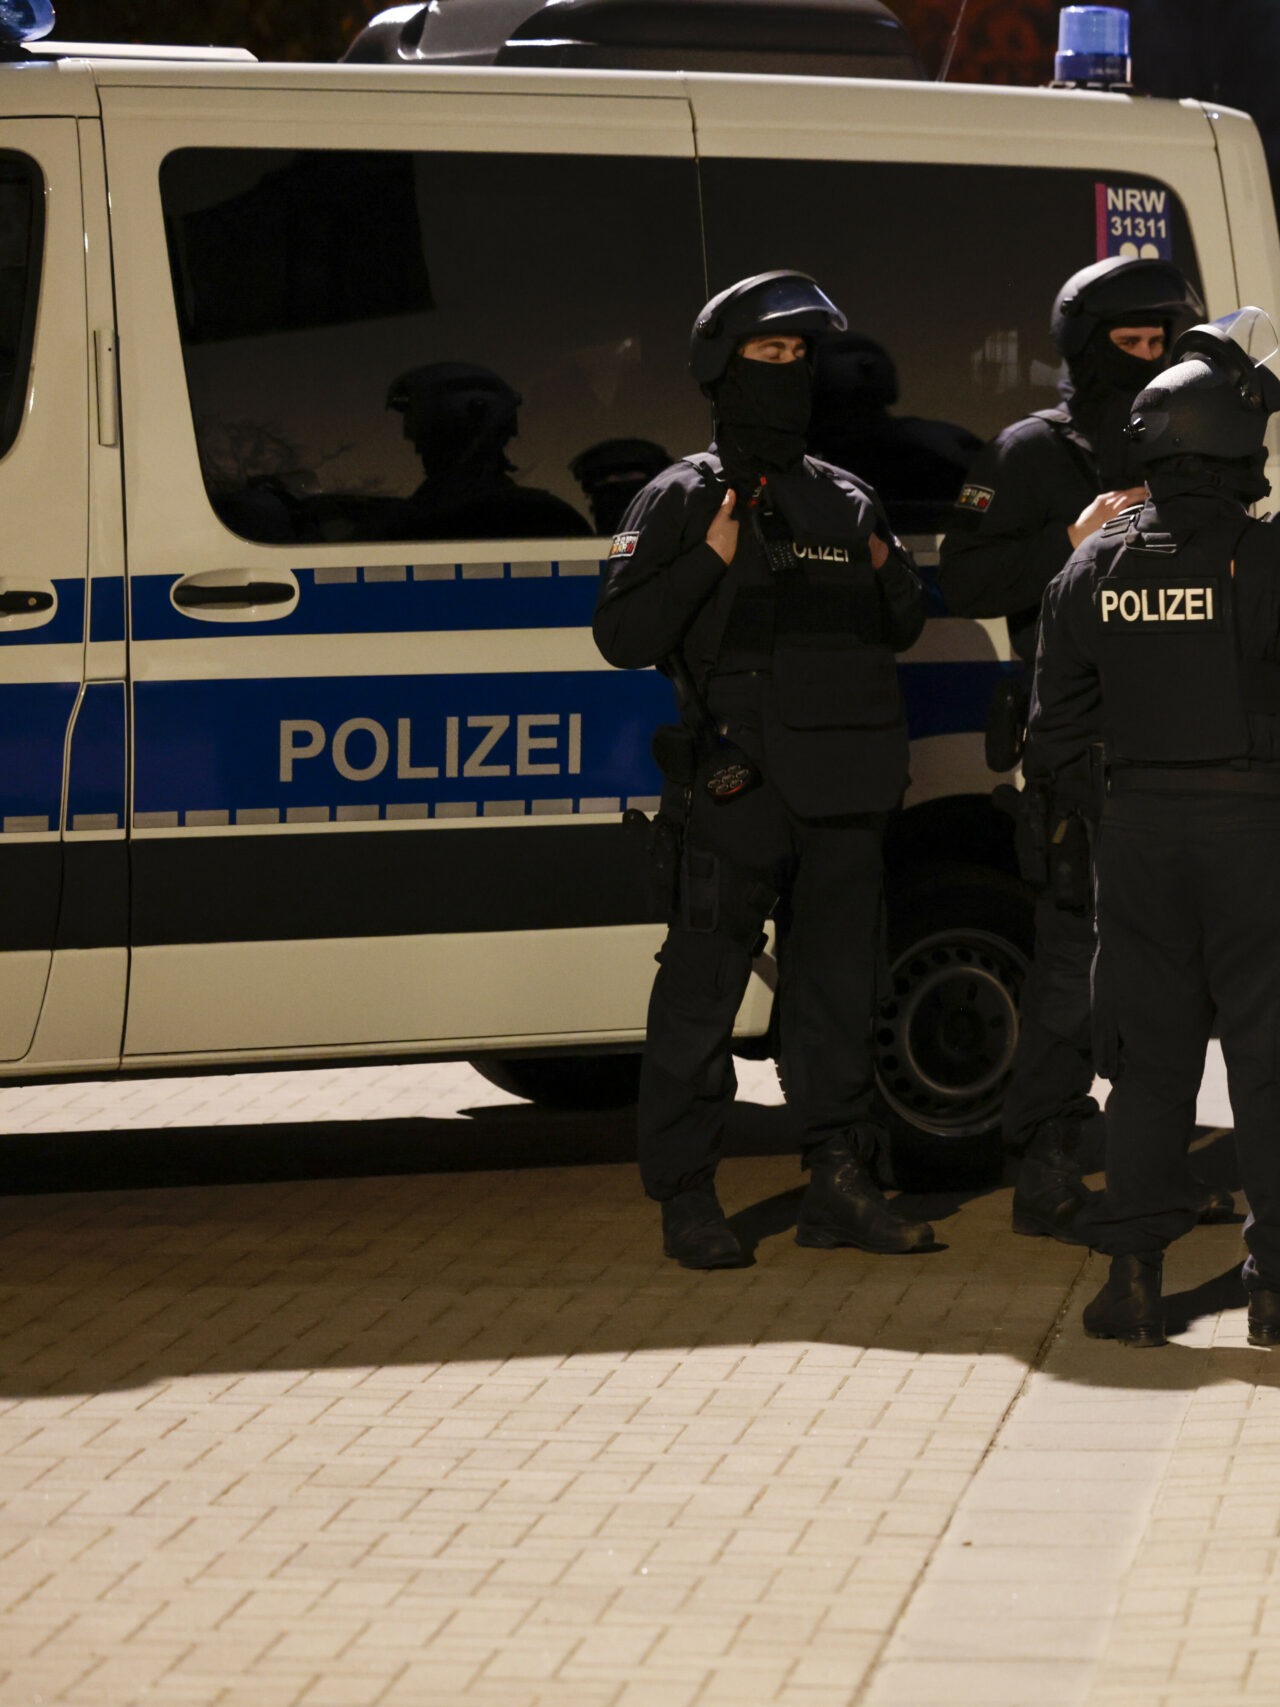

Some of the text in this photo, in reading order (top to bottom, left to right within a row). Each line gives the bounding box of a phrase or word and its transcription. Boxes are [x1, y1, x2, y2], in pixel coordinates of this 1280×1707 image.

[1106, 187, 1166, 214] NRW
[1110, 215, 1166, 239] 31311
[792, 541, 849, 563] OLIZEI
[1100, 587, 1214, 622] POLIZEI
[279, 712, 583, 783] POLIZEI
